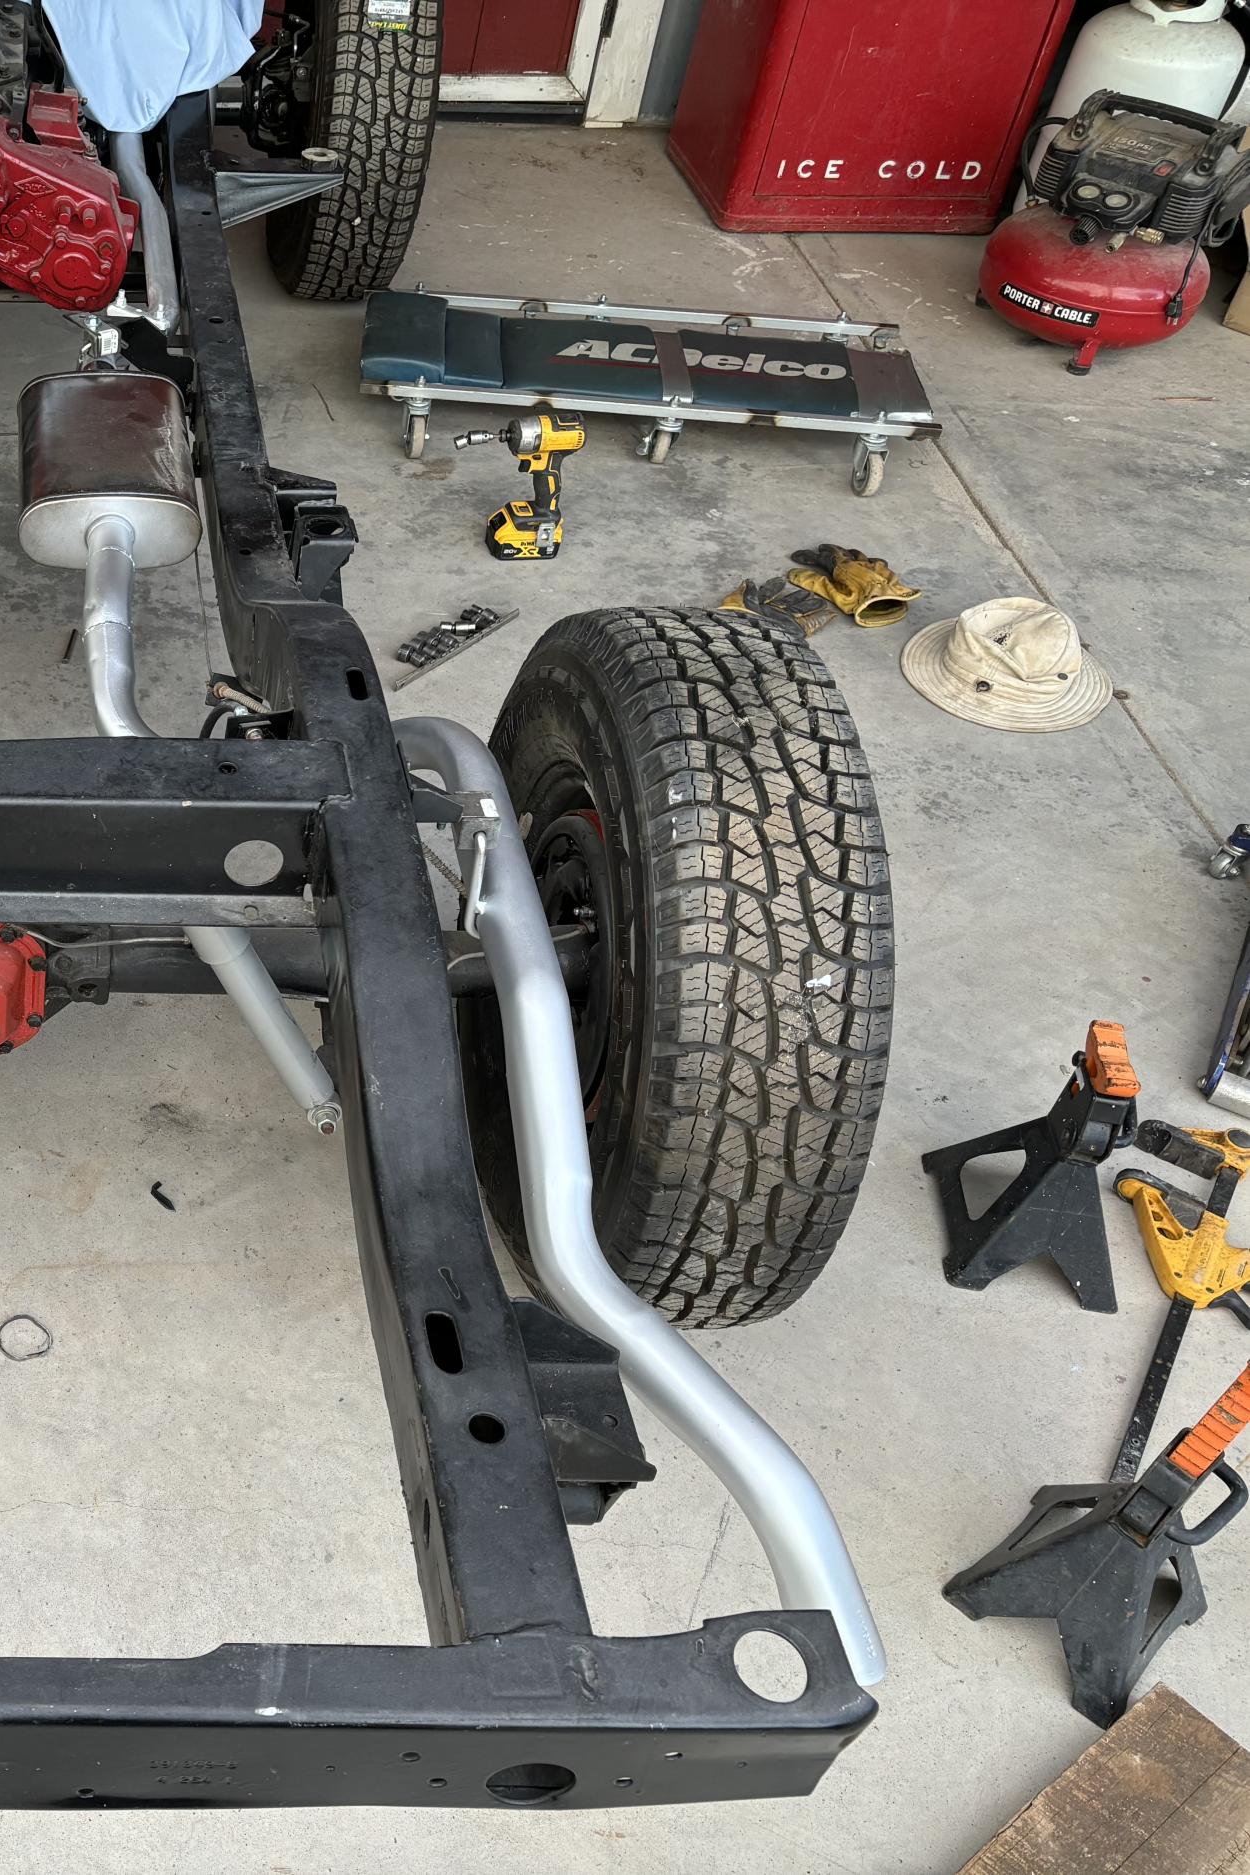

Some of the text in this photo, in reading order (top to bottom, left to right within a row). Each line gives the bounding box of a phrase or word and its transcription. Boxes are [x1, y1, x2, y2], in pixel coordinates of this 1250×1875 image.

[776, 159, 982, 180] ICE COLD
[1003, 284, 1092, 324] PORTER CABLE
